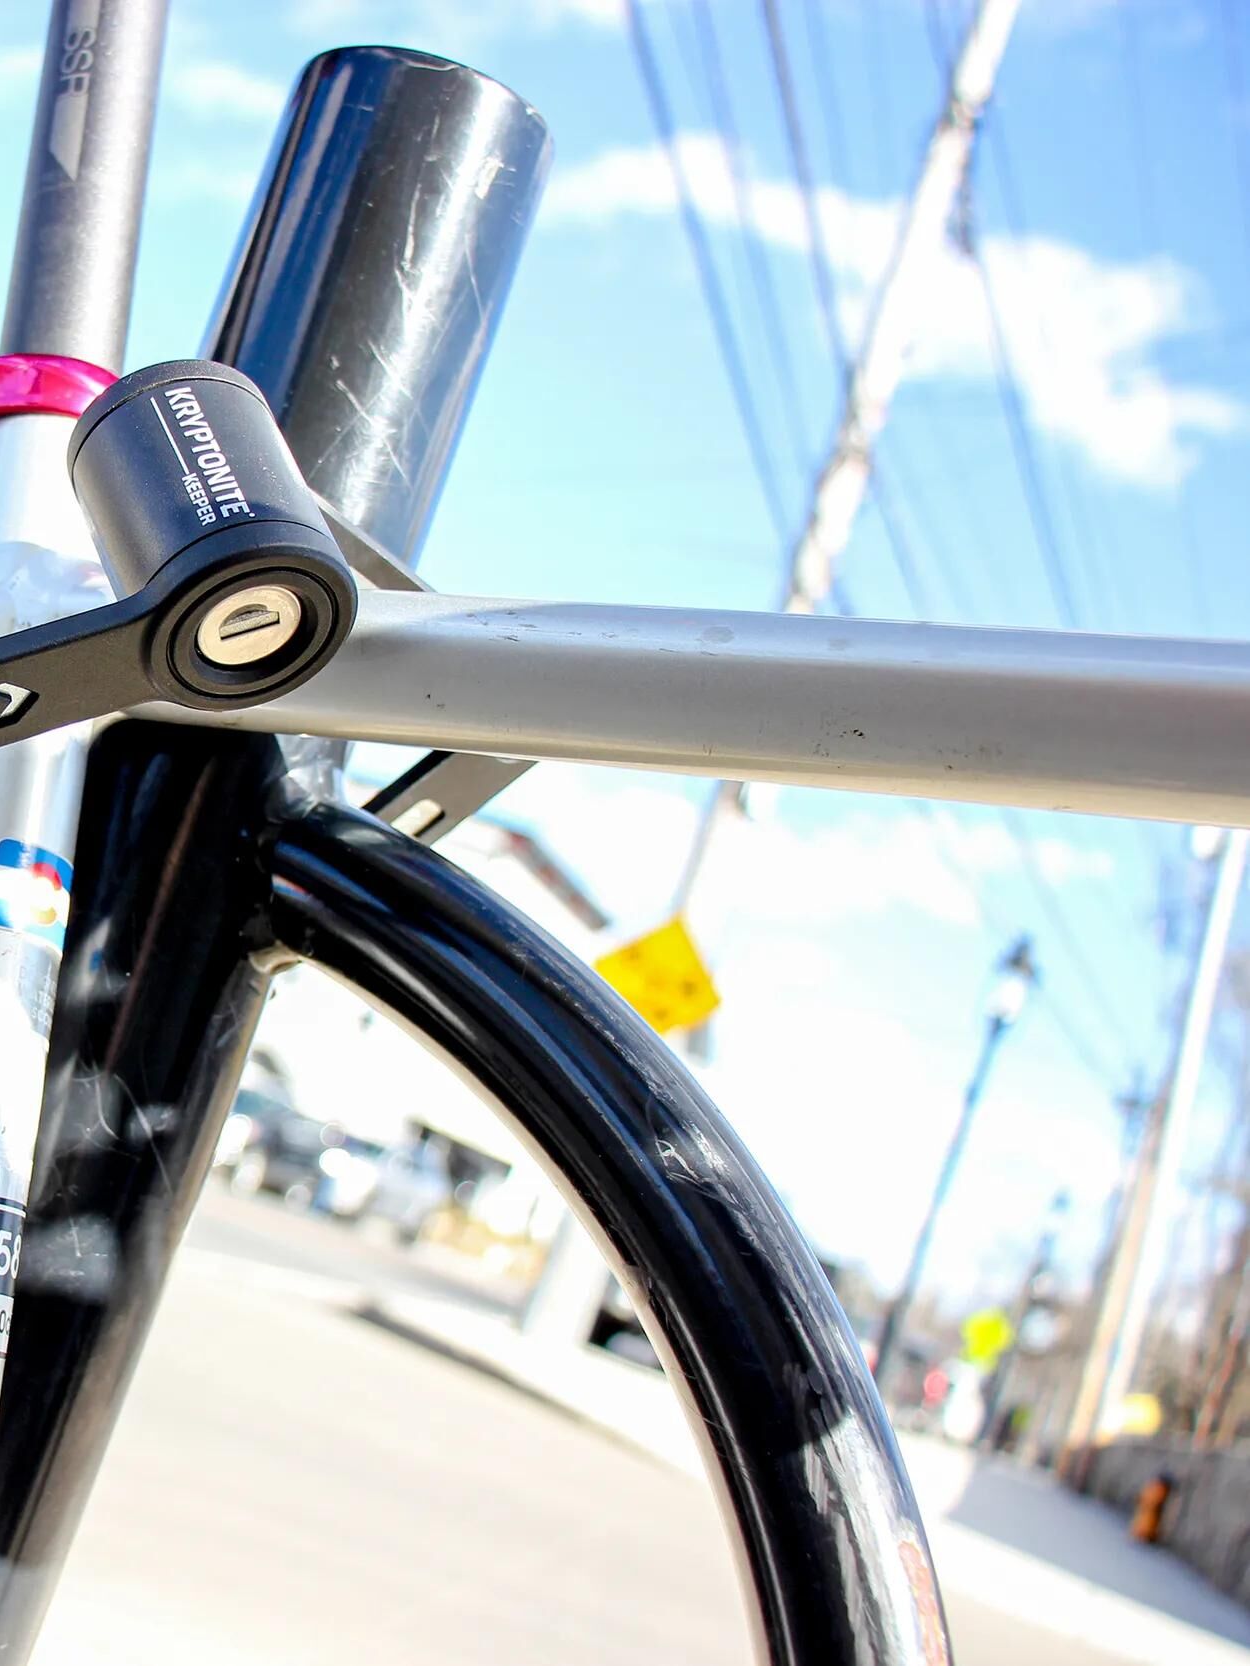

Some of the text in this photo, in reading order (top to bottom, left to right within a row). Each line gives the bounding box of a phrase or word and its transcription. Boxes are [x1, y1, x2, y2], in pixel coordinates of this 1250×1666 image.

[60, 27, 96, 97] SSR
[163, 386, 251, 518] KRYPTONITE
[181, 472, 217, 526] KEEPER
